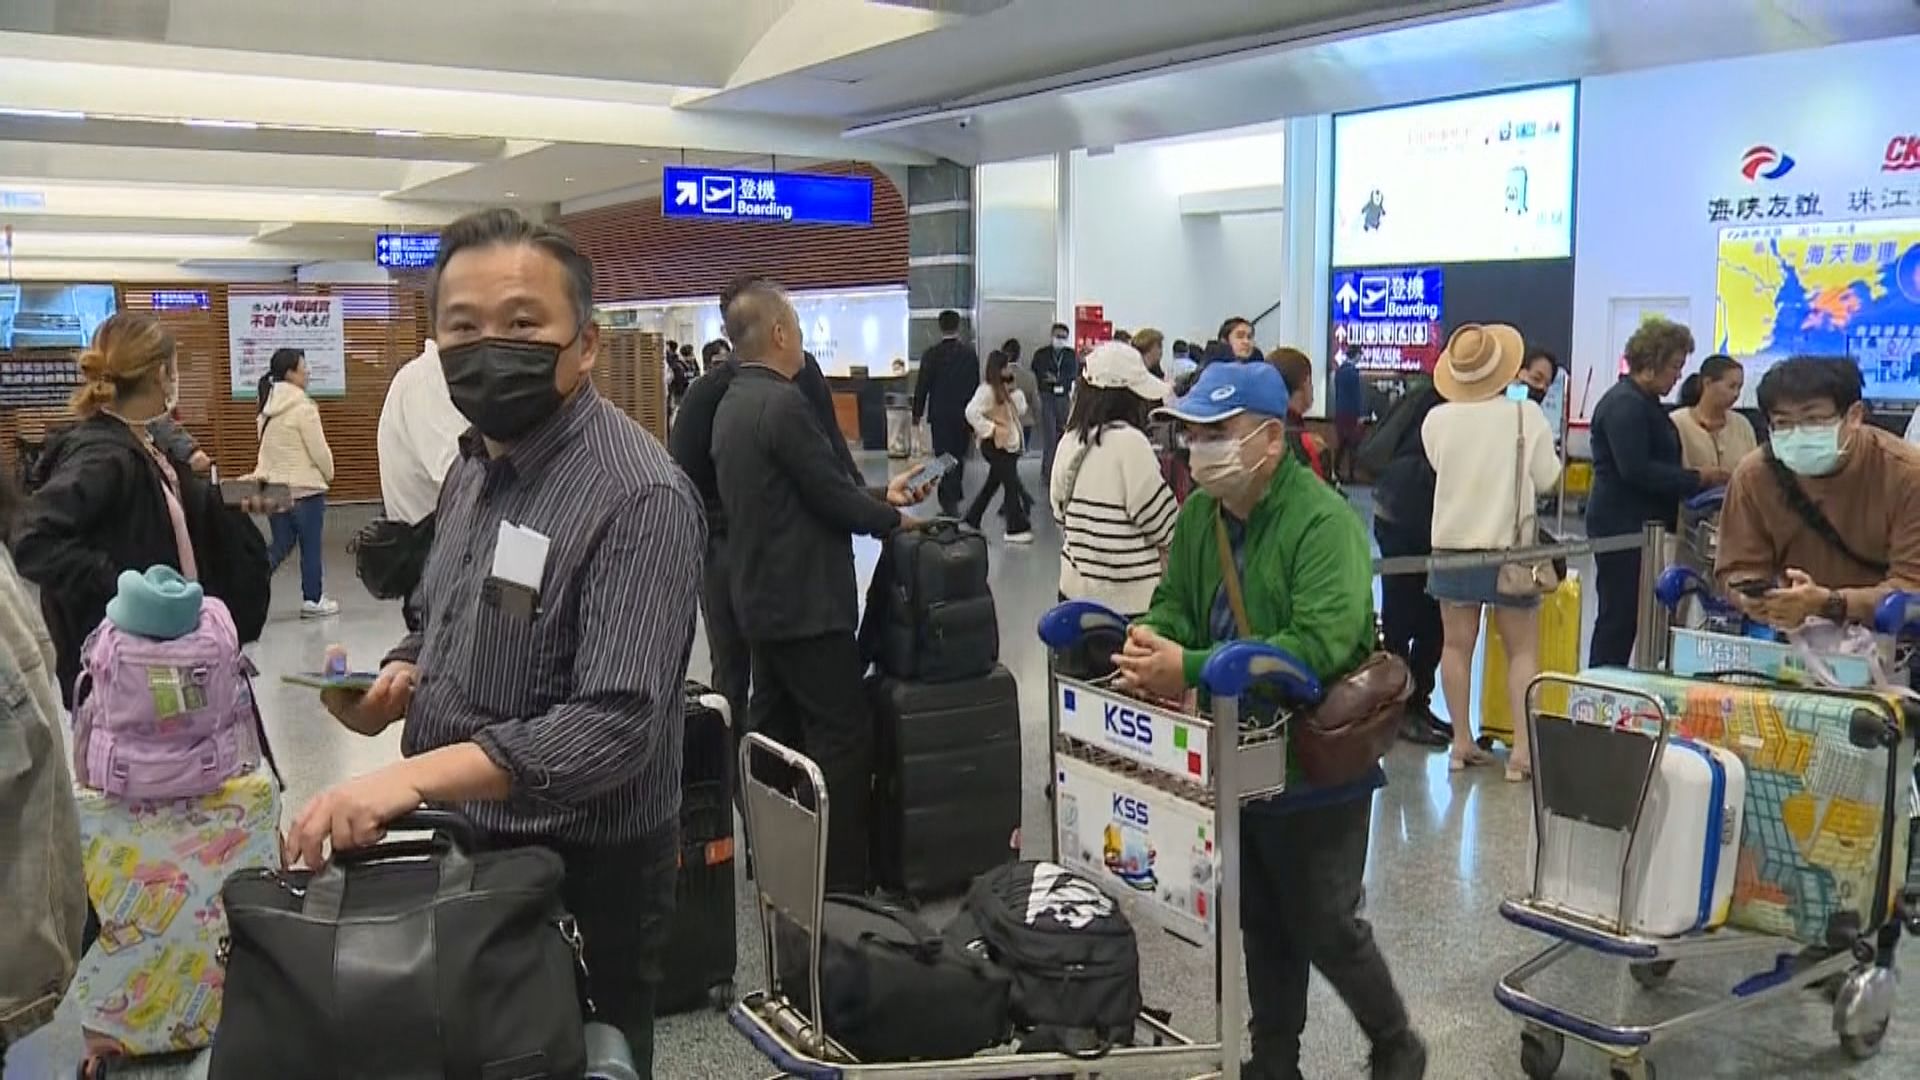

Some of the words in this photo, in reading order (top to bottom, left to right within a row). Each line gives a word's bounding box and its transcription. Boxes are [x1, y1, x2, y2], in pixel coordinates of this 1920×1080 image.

[738, 178, 776, 201] 登機
[1848, 186, 1920, 213] 珠江
[737, 201, 793, 219] Boarding
[1389, 276, 1425, 300] 登機
[1388, 301, 1439, 320] Boarding
[1104, 702, 1153, 744] KSS
[1113, 792, 1150, 825] KSS
